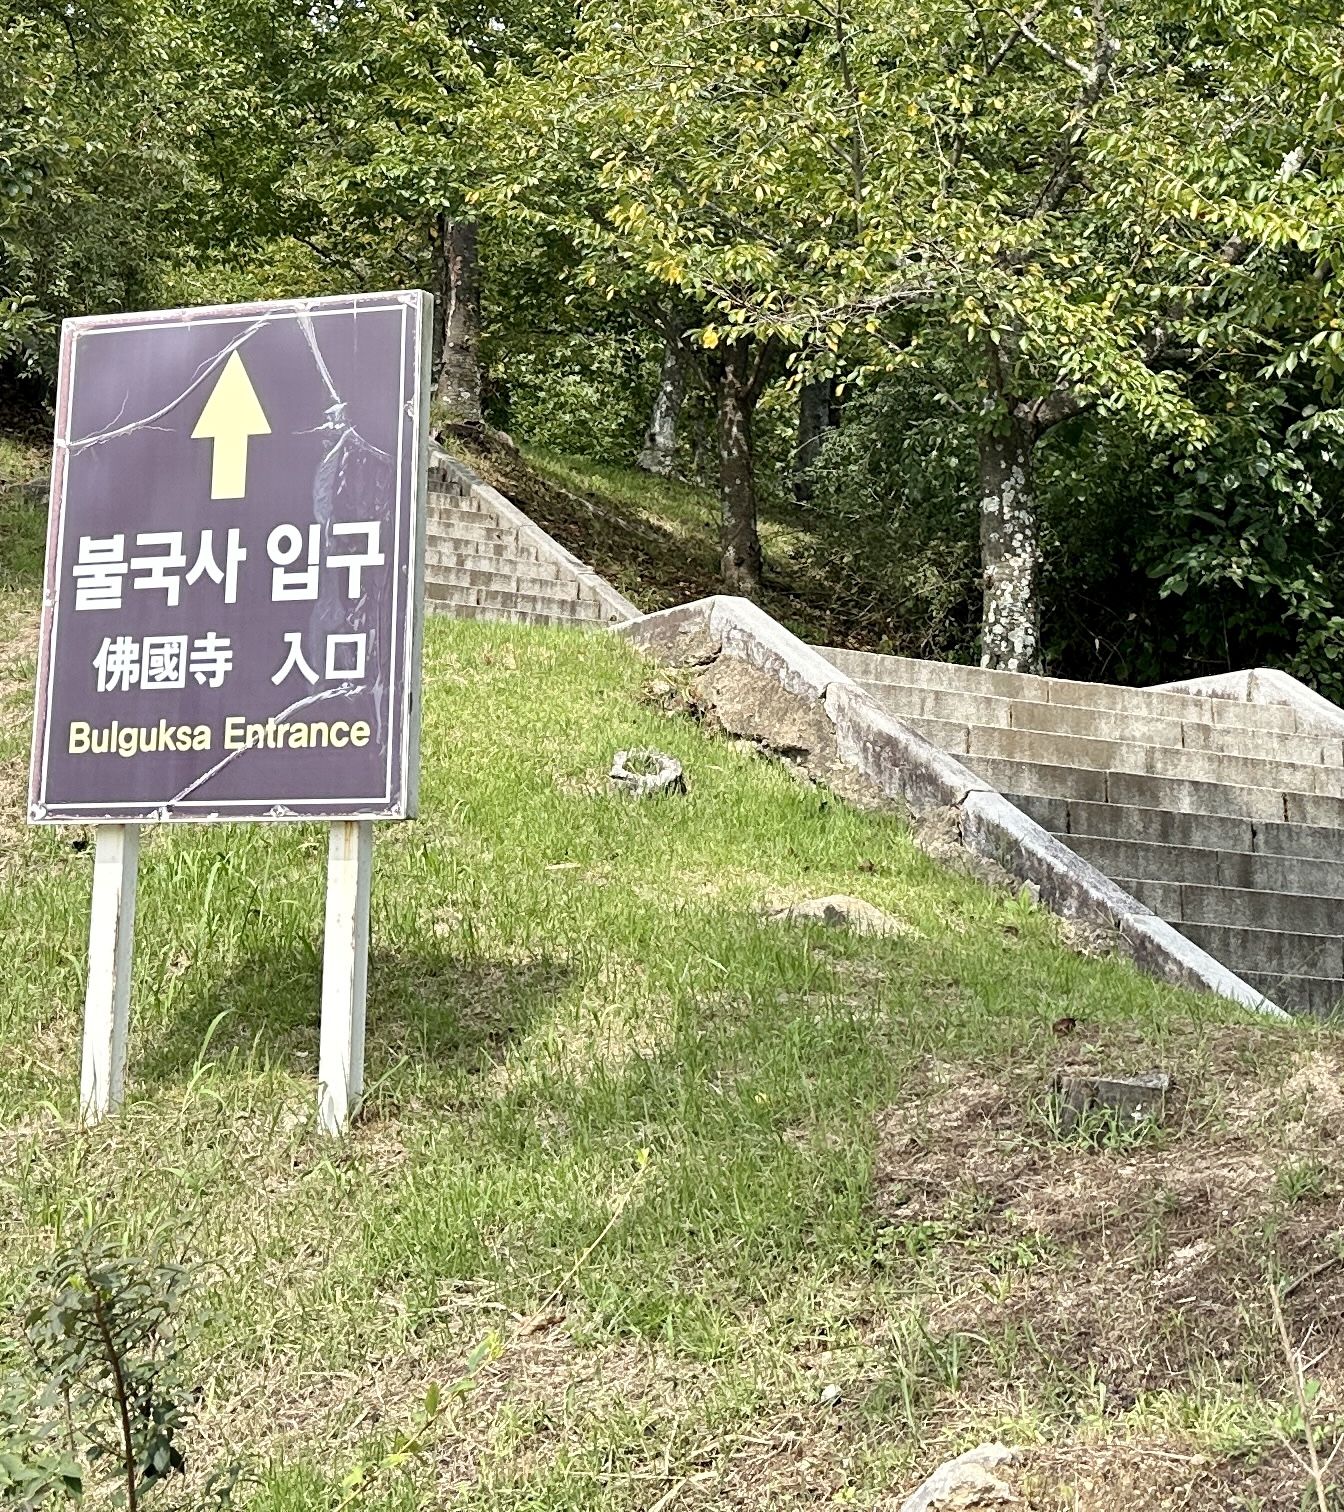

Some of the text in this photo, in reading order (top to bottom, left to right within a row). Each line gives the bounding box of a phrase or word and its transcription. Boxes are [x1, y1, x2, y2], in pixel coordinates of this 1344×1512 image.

[72, 521, 385, 611] 불국사 입구
[92, 631, 367, 692] 佛國寺 入口
[68, 716, 371, 758] Bulguksa Entrance
